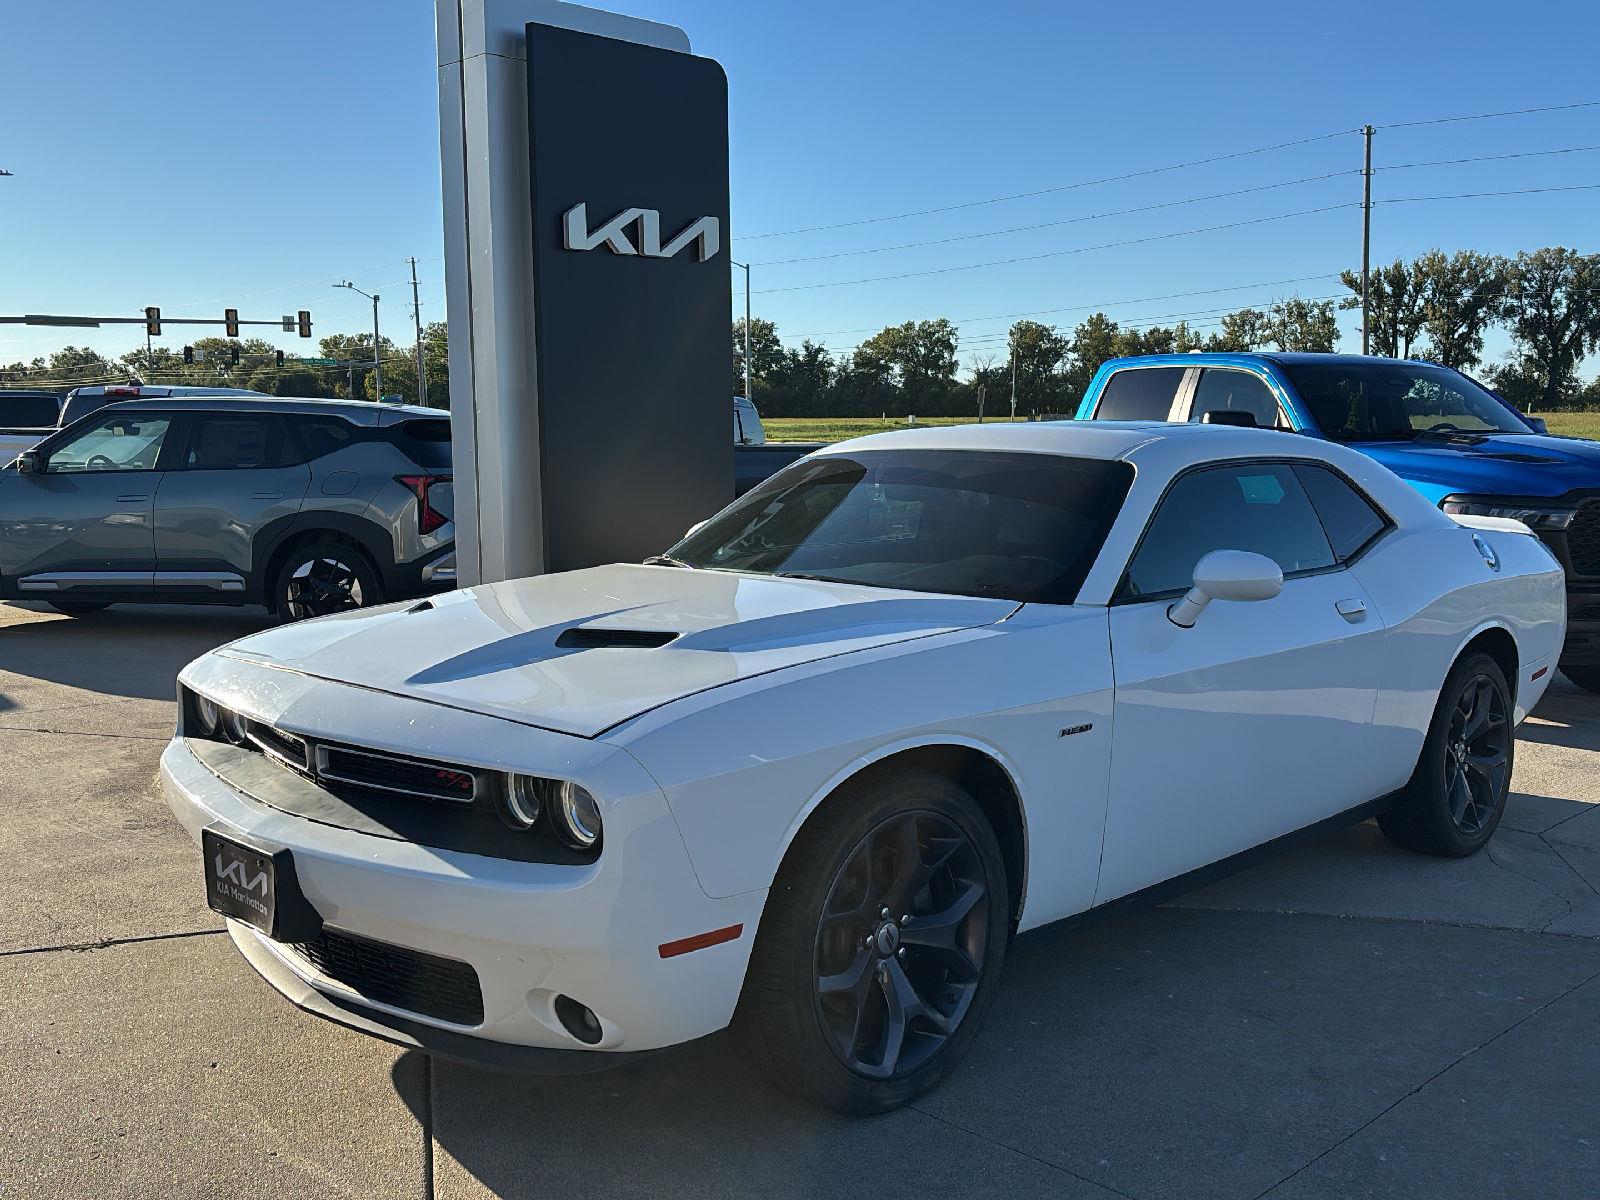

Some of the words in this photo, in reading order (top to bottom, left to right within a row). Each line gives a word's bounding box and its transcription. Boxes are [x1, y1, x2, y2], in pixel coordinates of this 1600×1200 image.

[564, 202, 719, 262] KIA
[216, 880, 230, 896] KIA
[231, 887, 268, 916] Manhattan
